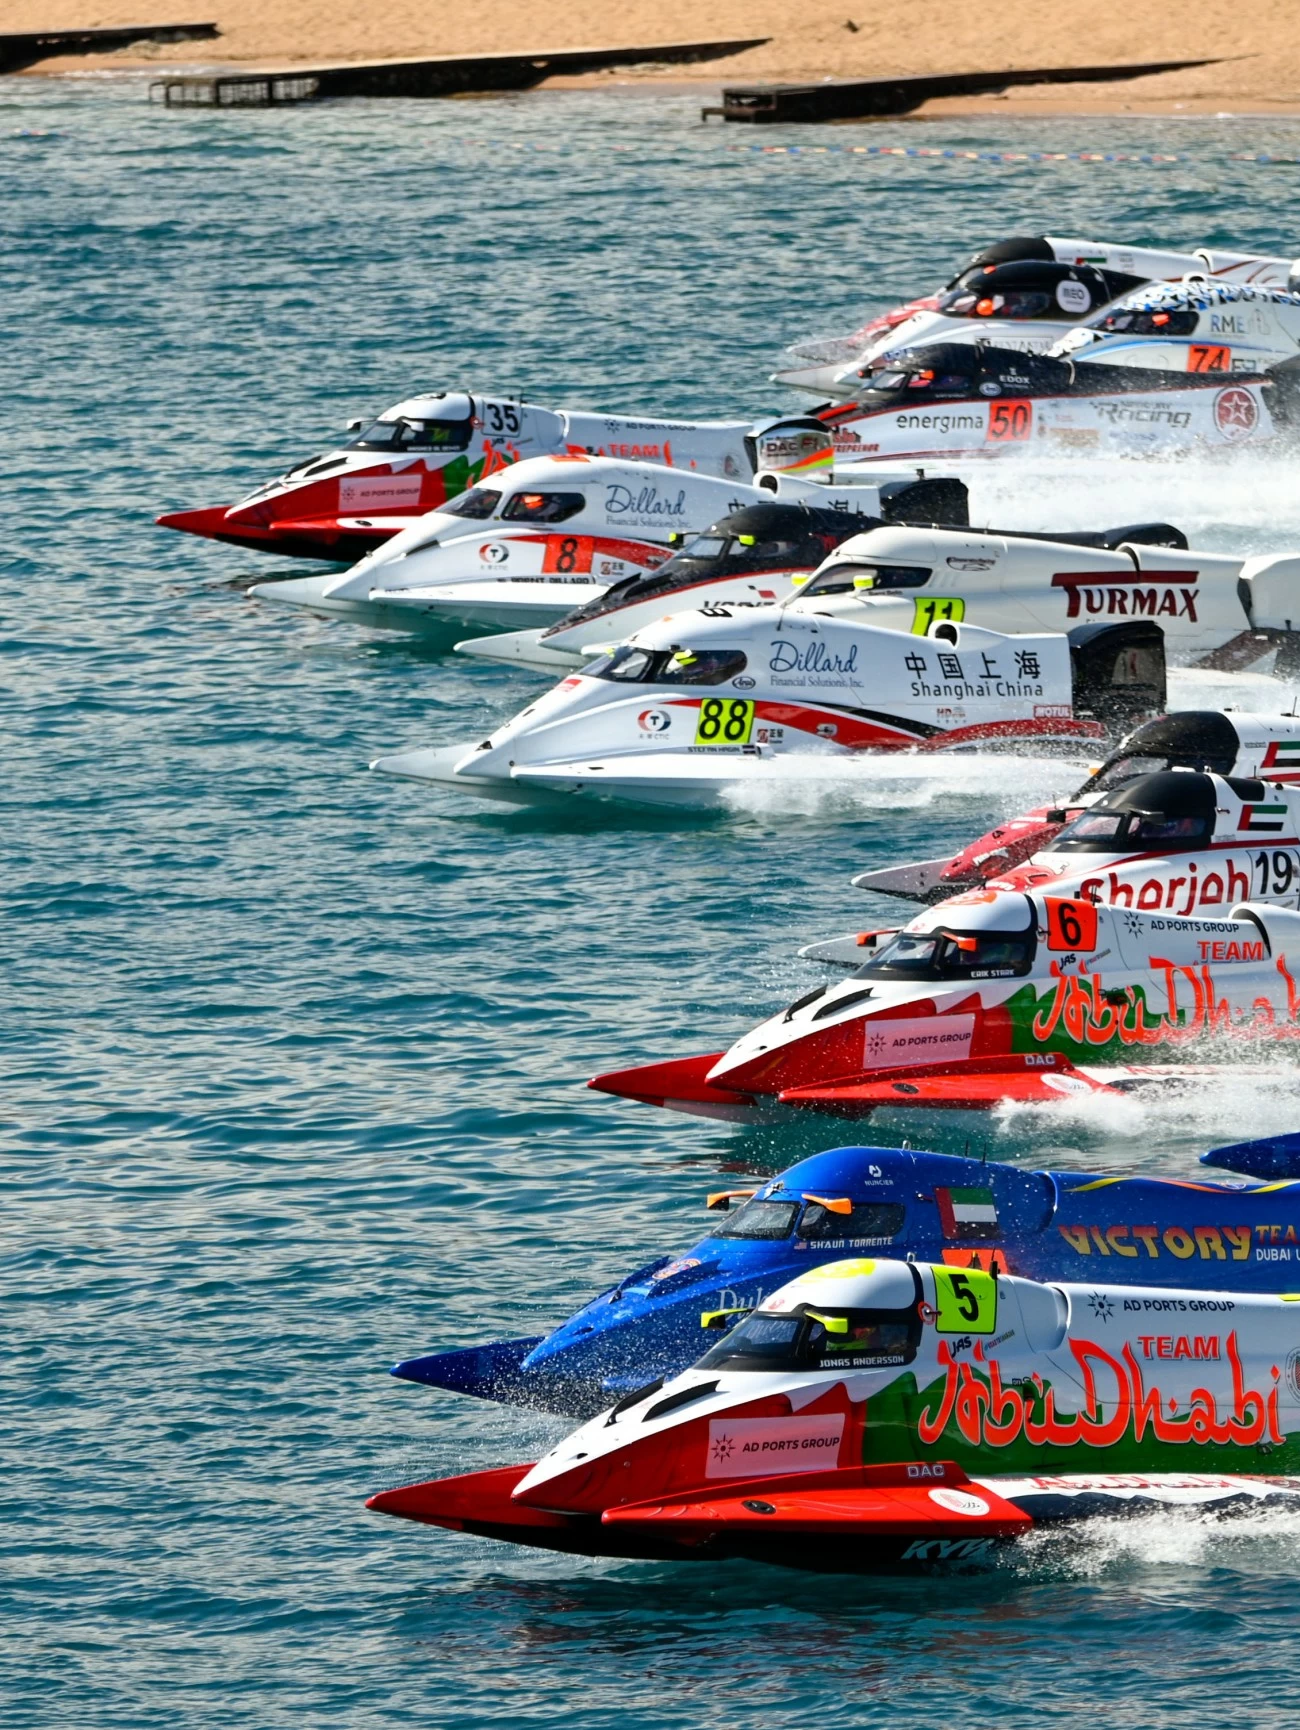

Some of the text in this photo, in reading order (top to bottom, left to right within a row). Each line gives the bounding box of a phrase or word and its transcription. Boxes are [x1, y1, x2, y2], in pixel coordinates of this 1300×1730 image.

[1211, 315, 1245, 333] RME
[1193, 349, 1224, 373] 74
[1000, 375, 1030, 385] EDOX
[486, 403, 518, 432] 35
[896, 414, 983, 434] energima
[991, 405, 1028, 438] 50
[608, 443, 661, 458] TEAM
[604, 484, 686, 515] Dillard
[556, 537, 578, 573] 8
[1051, 571, 1200, 622] TURMAX
[924, 601, 953, 636] 11
[769, 640, 858, 673] Dillard
[904, 650, 1041, 680] 中国上海
[770, 675, 806, 686] Financial
[911, 682, 1043, 700] Shanghai China
[699, 699, 748, 740] 88
[1034, 706, 1073, 719] MOTUL
[1254, 850, 1293, 895] 19
[1058, 902, 1081, 946] 6
[1150, 920, 1240, 933] AD PORTS GROUP
[1197, 941, 1264, 962] TEAM
[990, 969, 1015, 977] STARK
[892, 1033, 972, 1047] AD PORTS GROUP
[1024, 1054, 1056, 1066] DAC
[809, 1237, 894, 1250] SHAUN TORRENTE
[1057, 1225, 1252, 1261] VICTORY
[1256, 1247, 1291, 1261] DUBAI
[947, 1273, 978, 1322] 5
[1123, 1300, 1236, 1313] AD PORTS GROUP
[951, 1335, 972, 1358] JAS
[1137, 1335, 1220, 1360] TEAM
[819, 1355, 905, 1368] JONAS ANDERSSON
[742, 1437, 840, 1453] AD PORTS GROUP
[906, 1465, 945, 1478] DAC
